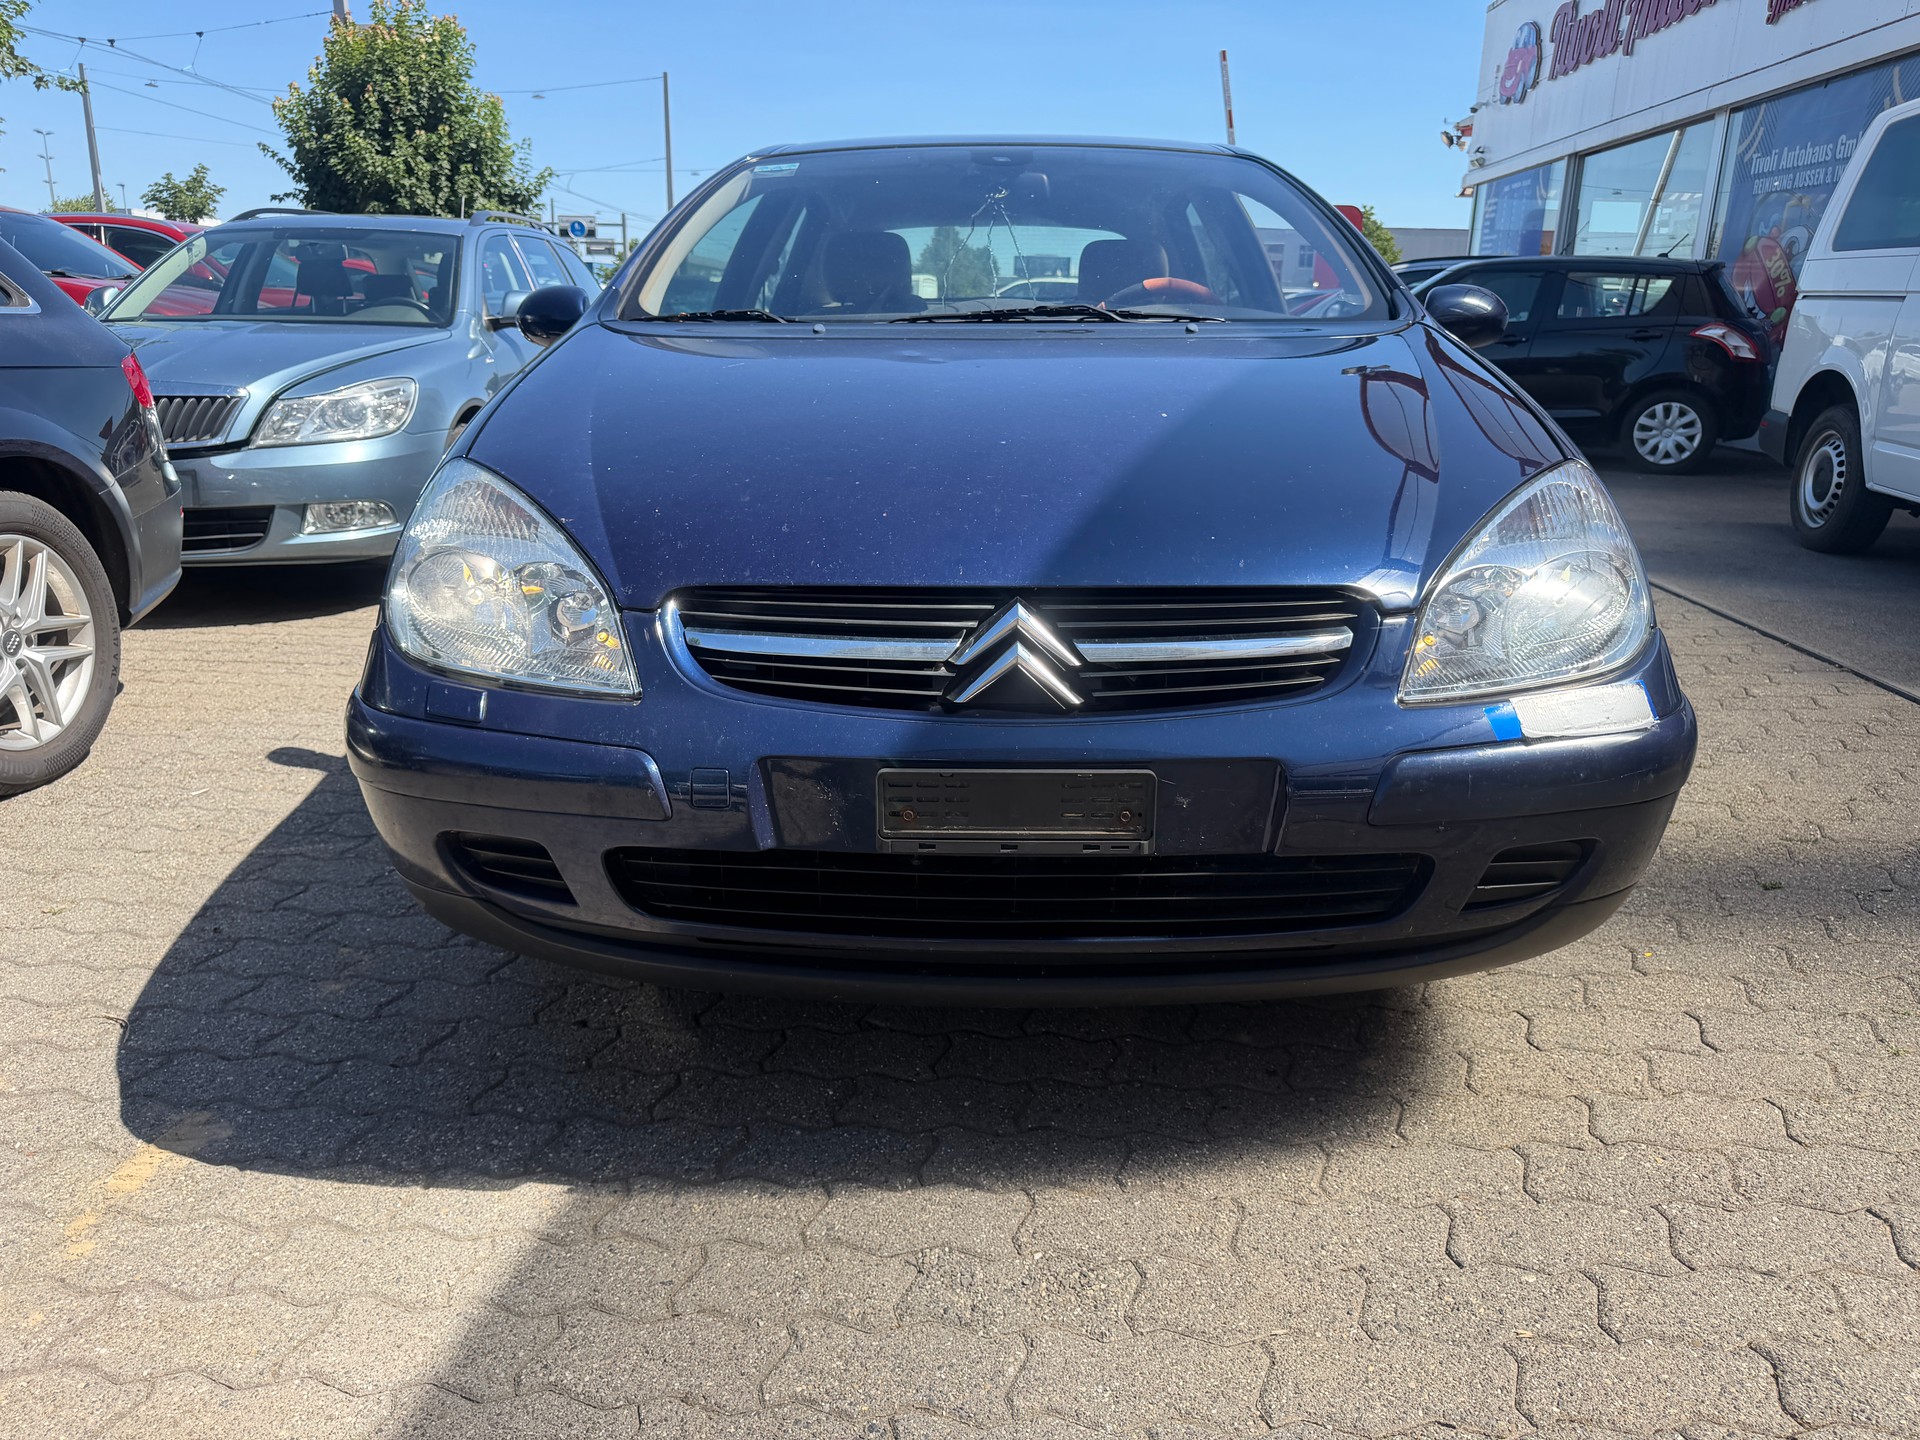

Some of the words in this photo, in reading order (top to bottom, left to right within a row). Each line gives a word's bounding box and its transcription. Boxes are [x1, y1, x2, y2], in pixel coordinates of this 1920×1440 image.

[1750, 149, 1779, 175] Tivoli
[1779, 142, 1833, 169] Autohaus
[1752, 174, 1793, 195] REINIGUNG
[1793, 166, 1826, 189] AUSSEN
[1826, 166, 1833, 184] &
[1766, 248, 1792, 298] 30%
